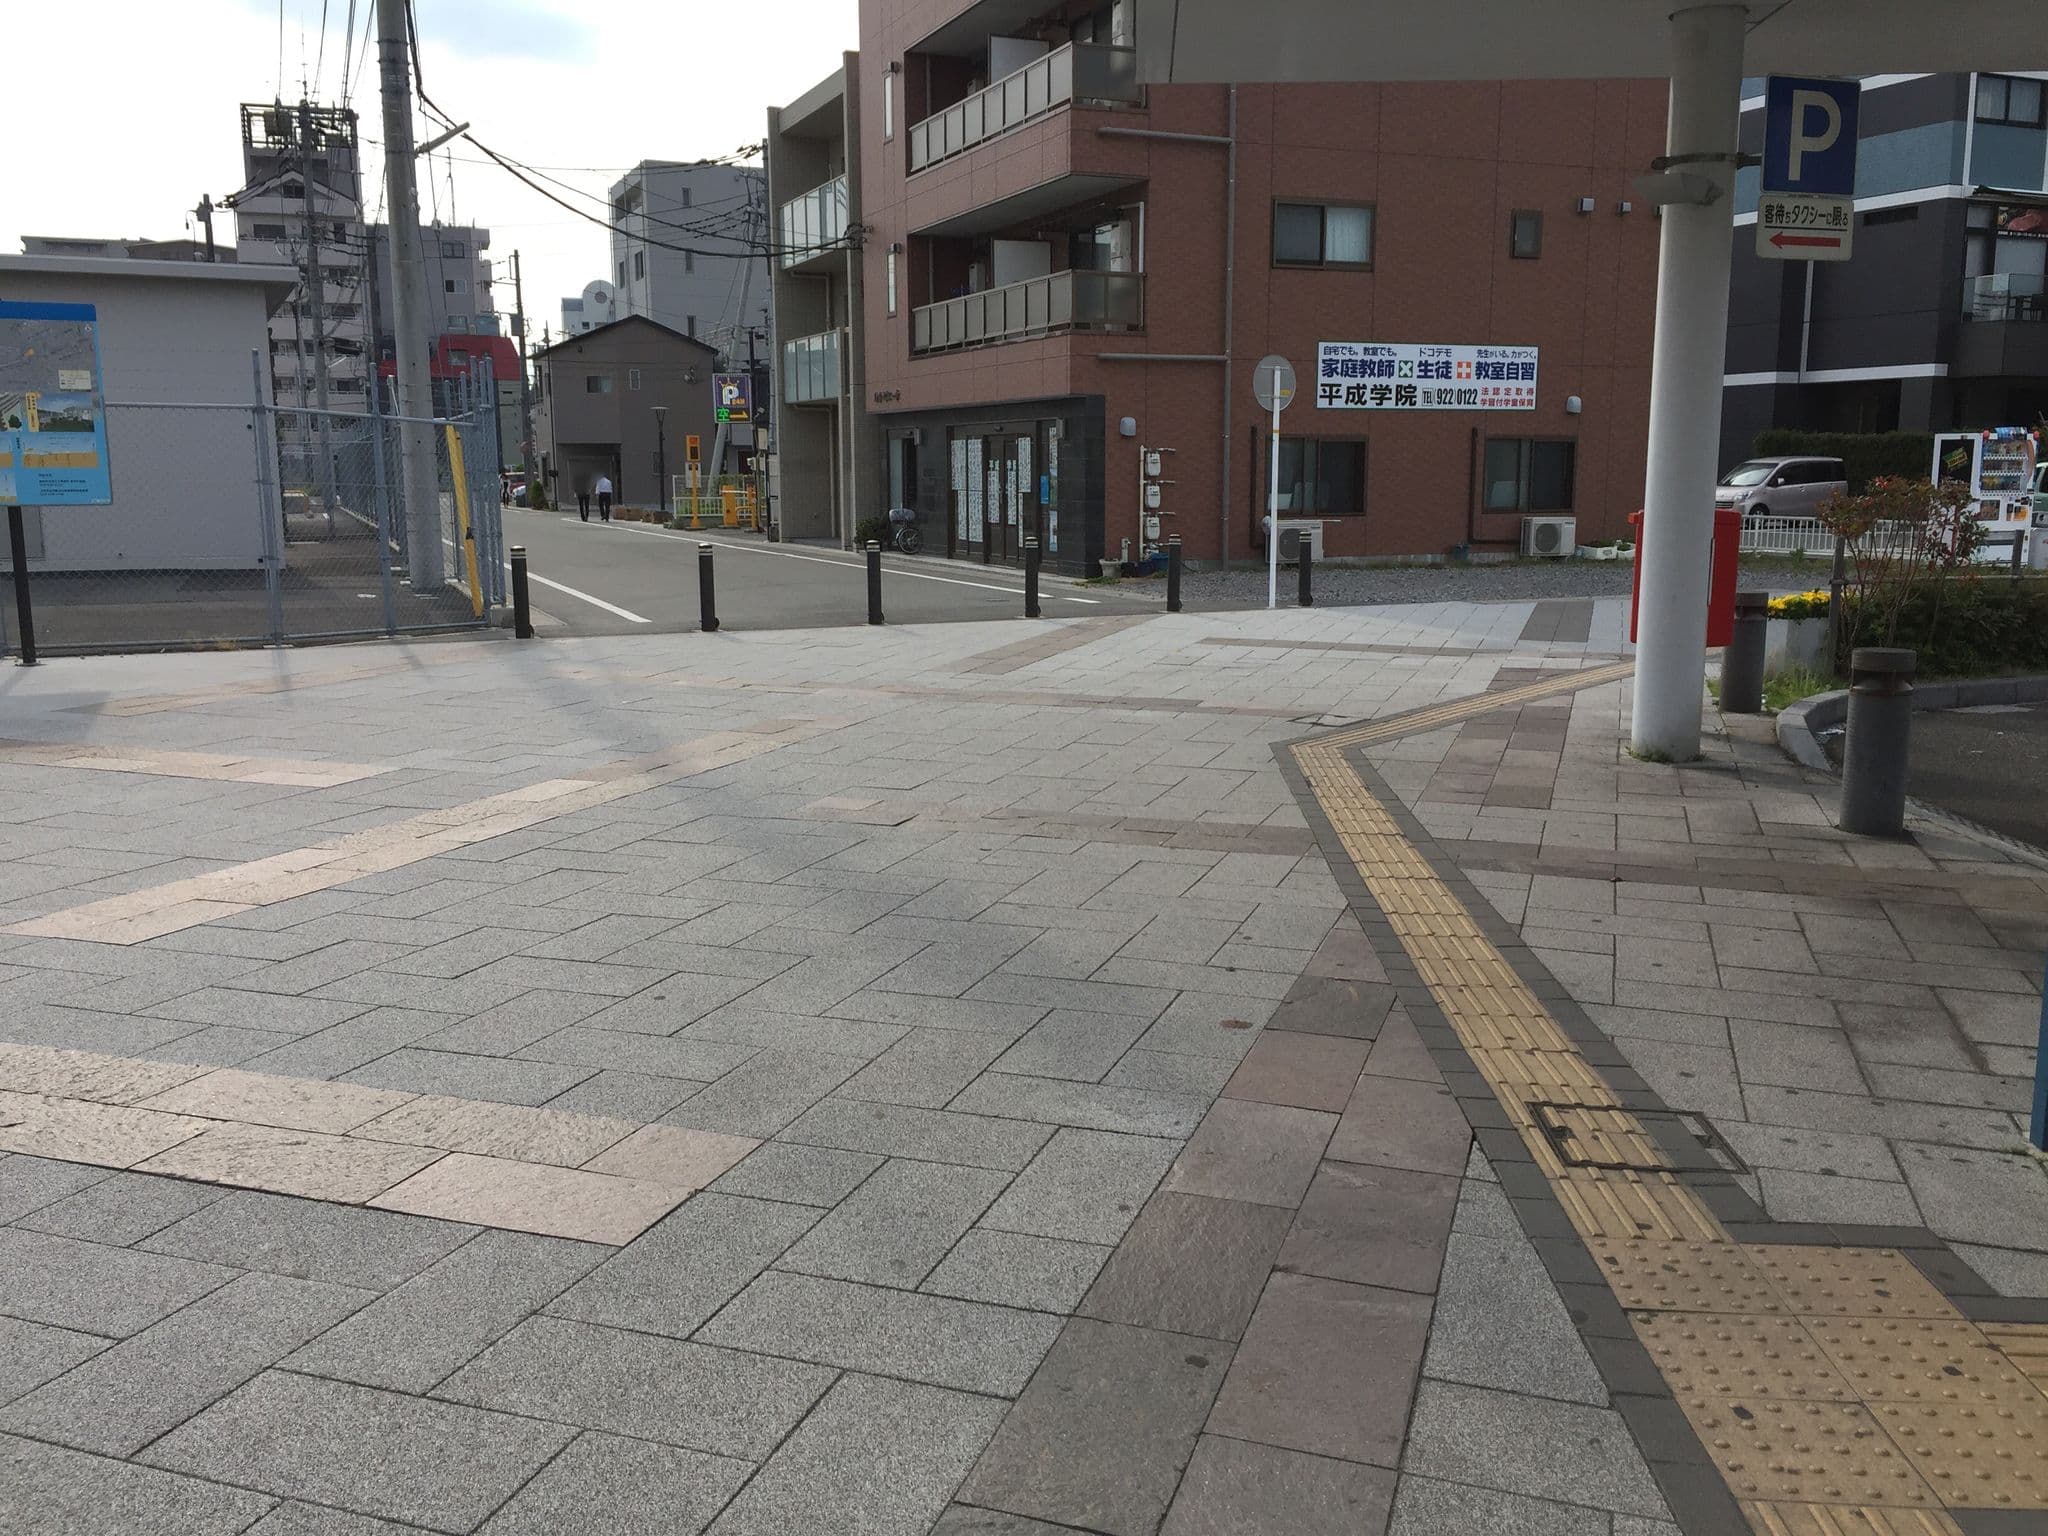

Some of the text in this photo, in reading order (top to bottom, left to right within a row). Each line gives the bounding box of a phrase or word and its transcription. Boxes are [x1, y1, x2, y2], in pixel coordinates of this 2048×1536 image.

[1788, 89, 1841, 181] P
[1764, 203, 1849, 227] 客待ちタクシーに限る
[1419, 347, 1452, 358] ドコデモ
[1321, 358, 1535, 381] 家庭教師 生徒 教室自習
[722, 385, 739, 405] P
[1319, 383, 1417, 406] 平成学院
[717, 407, 730, 421] 空
